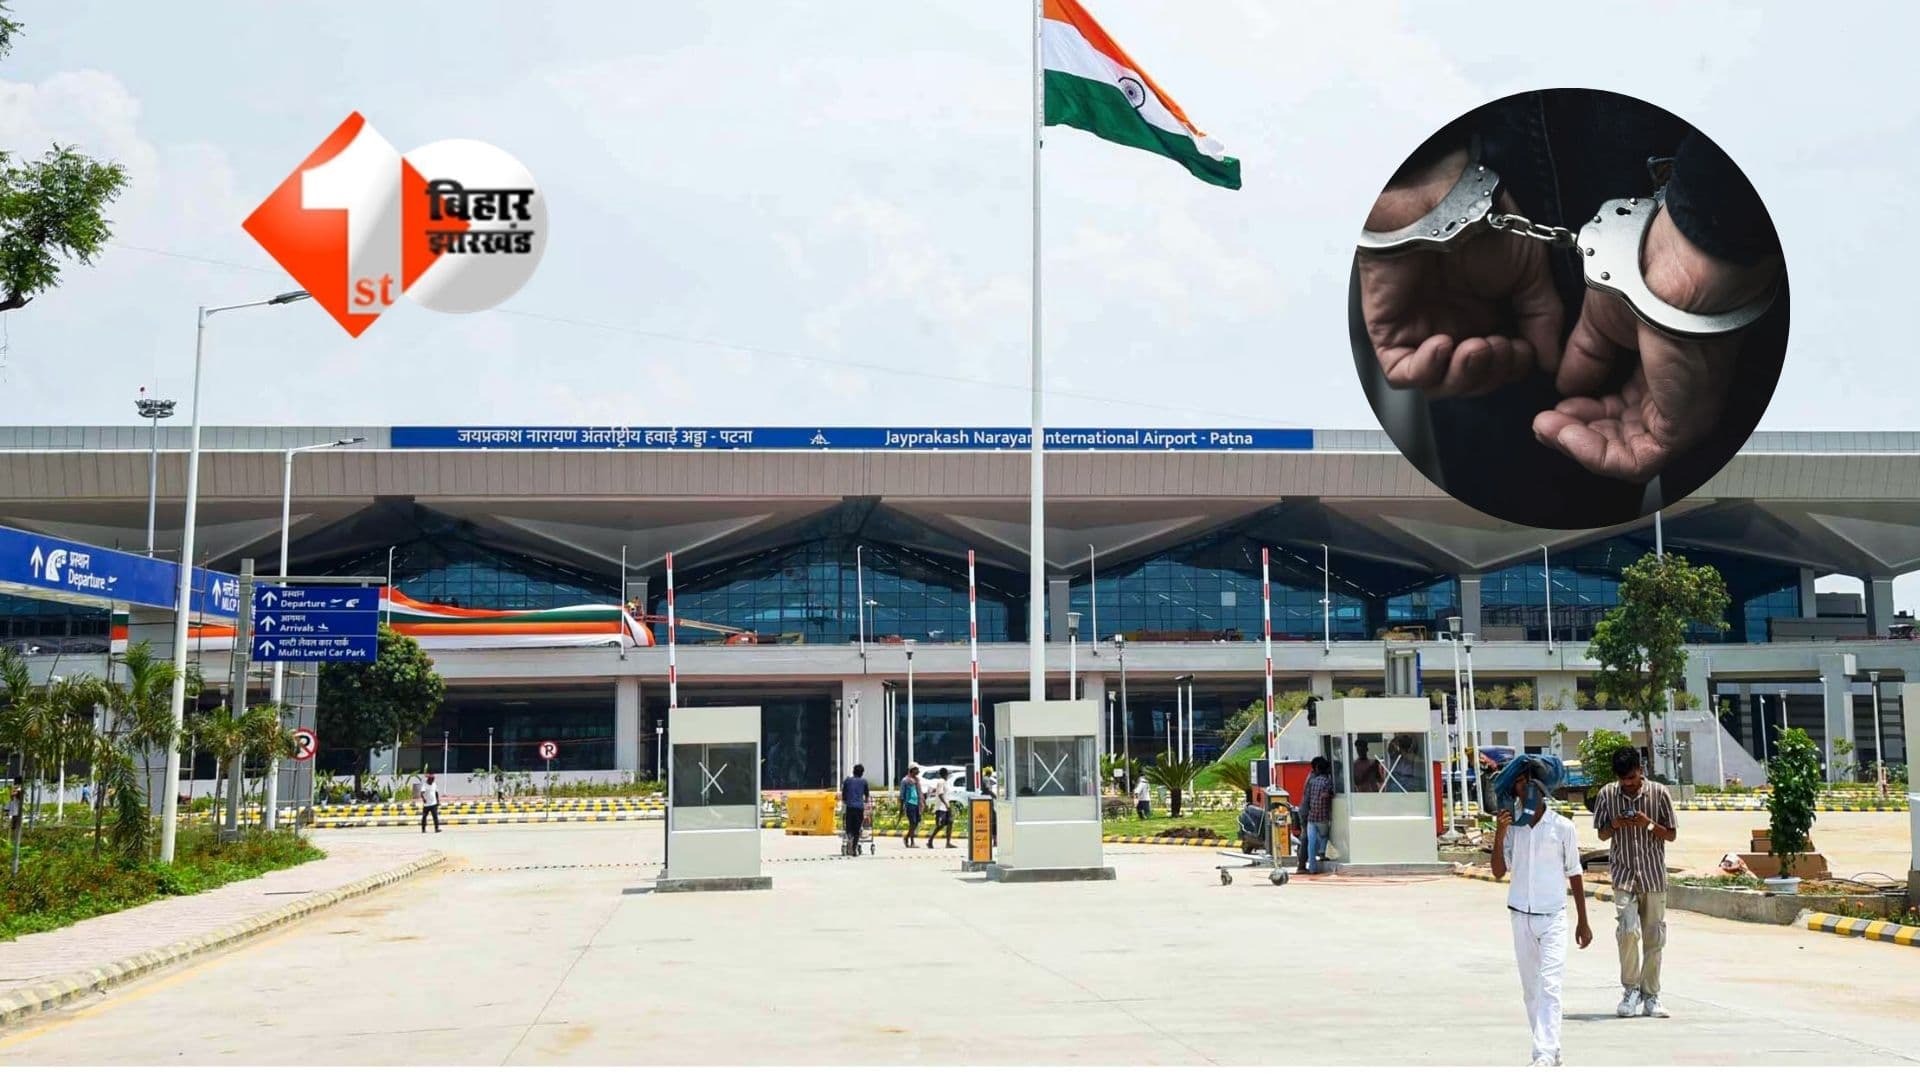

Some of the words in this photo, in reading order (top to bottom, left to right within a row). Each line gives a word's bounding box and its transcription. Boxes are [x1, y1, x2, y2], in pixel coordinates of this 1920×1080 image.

[457, 430, 523, 443] जयप्रकाश
[526, 430, 578, 443] नारायण
[644, 427, 677, 444] हवाई
[681, 430, 707, 447] अड्डा
[719, 430, 753, 443] पटना
[884, 430, 969, 448] Jayprakash
[1143, 430, 1198, 447] Airport
[1210, 432, 1253, 445] Patna
[67, 568, 106, 591] Departure
[280, 600, 326, 609] Departure
[280, 624, 314, 632] Arrivals
[278, 648, 302, 657] Multi
[303, 648, 327, 657] Level
[329, 648, 343, 657] Car
[346, 648, 366, 657] Park
